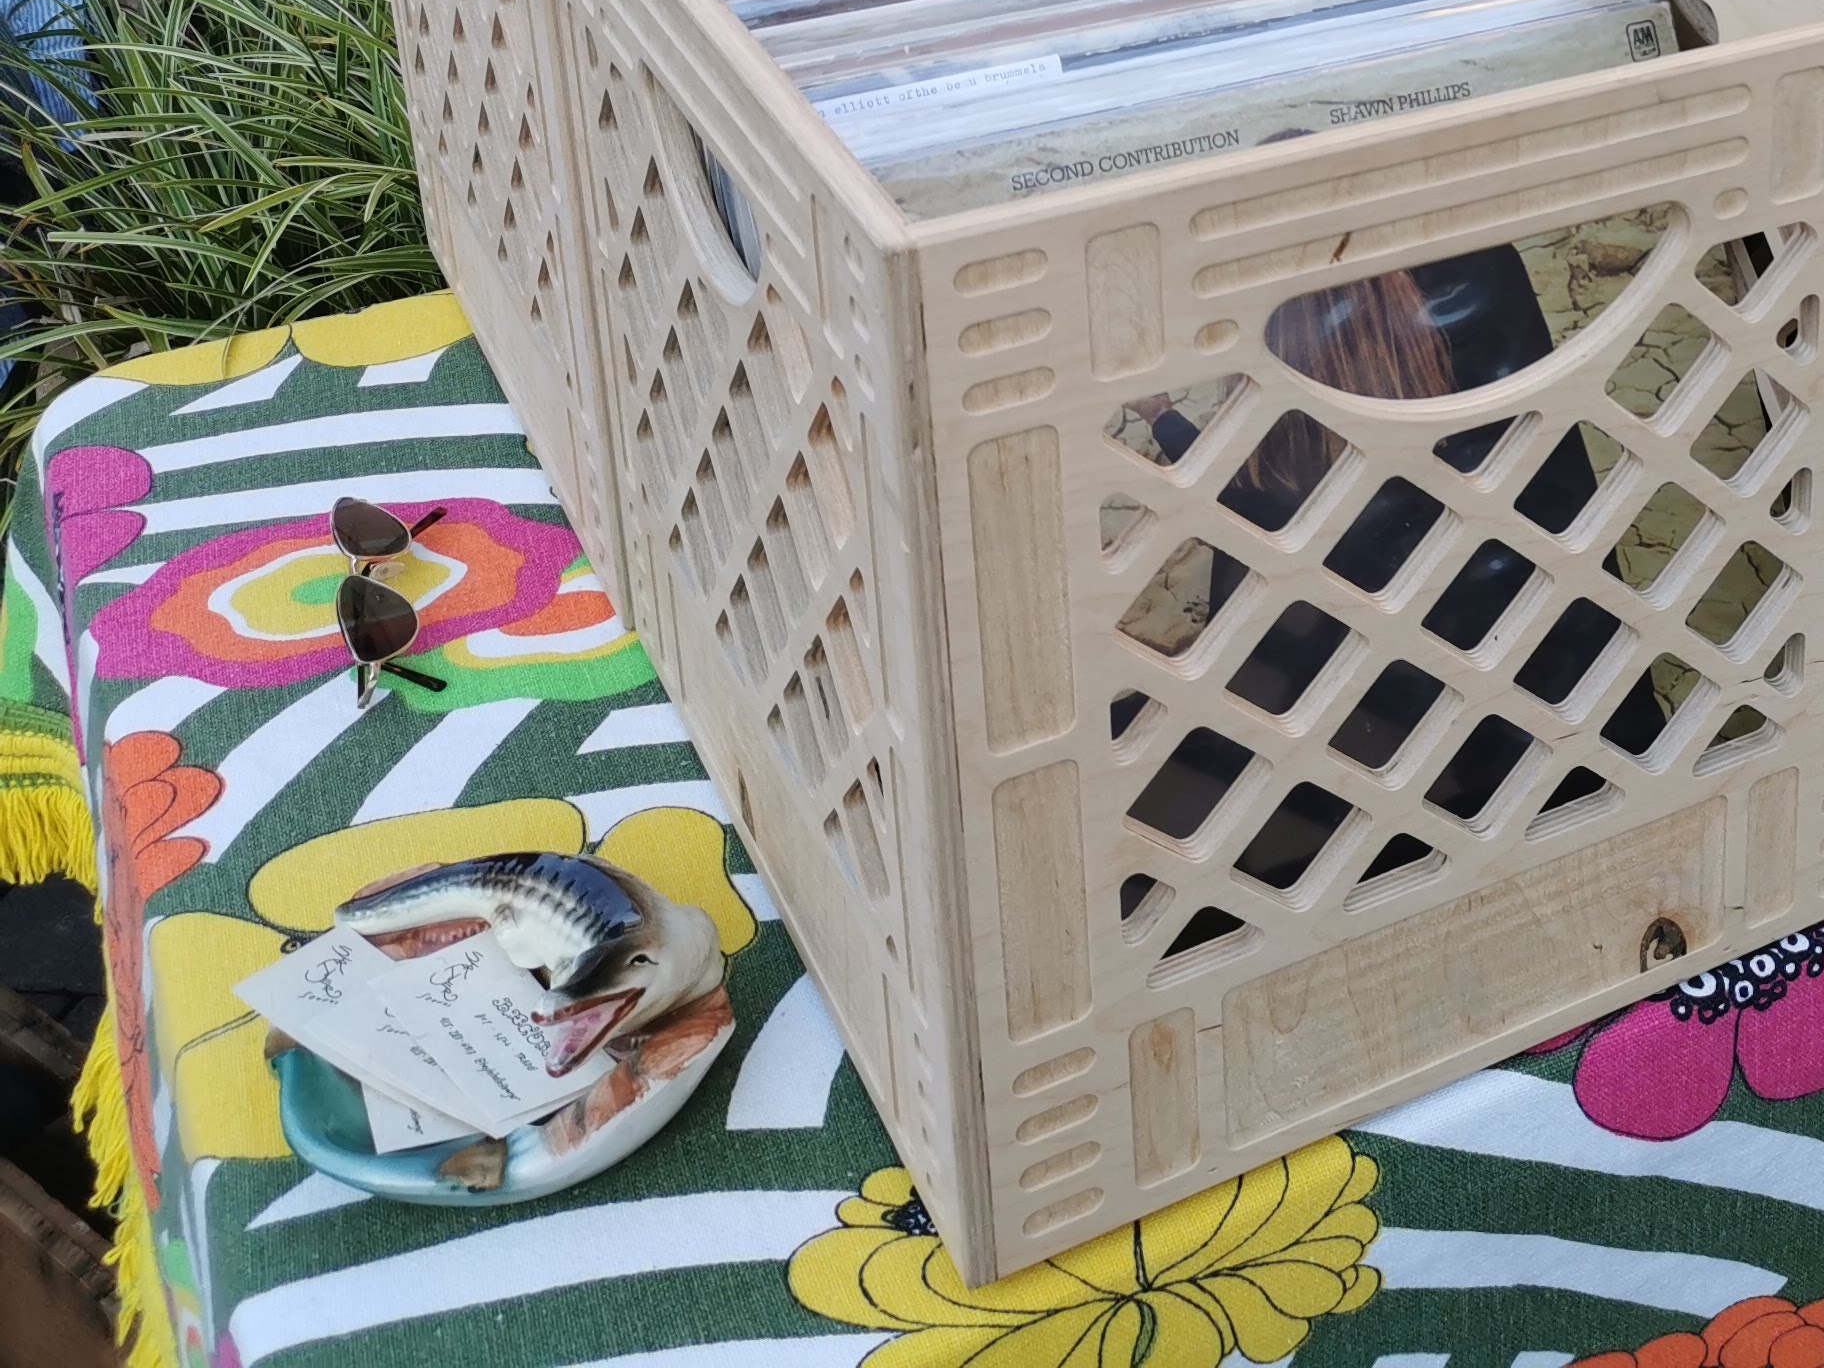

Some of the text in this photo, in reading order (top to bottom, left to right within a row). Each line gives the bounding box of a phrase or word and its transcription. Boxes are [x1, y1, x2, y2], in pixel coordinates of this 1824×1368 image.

[833, 94, 891, 117] elliott
[1329, 81, 1471, 125] SHAWN PHILLIPS
[1011, 129, 1241, 192] SECOND CONTRIBUTION
